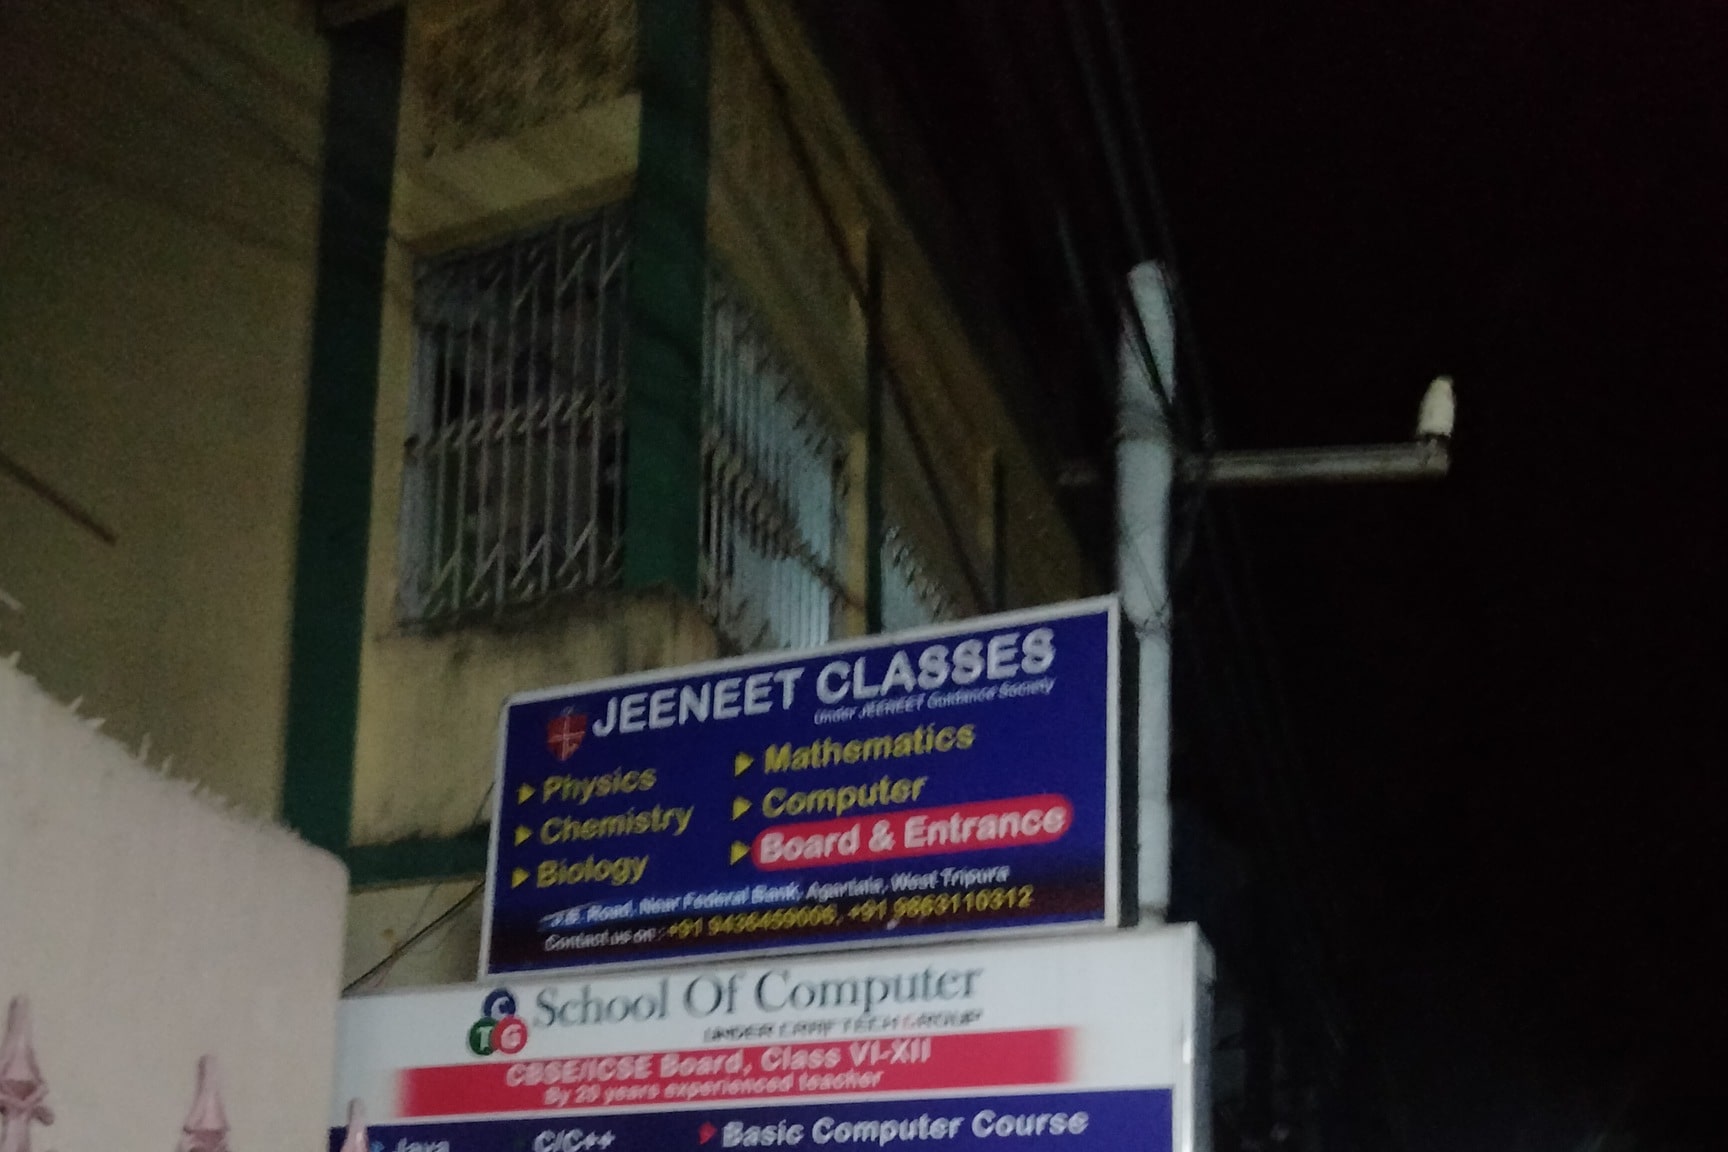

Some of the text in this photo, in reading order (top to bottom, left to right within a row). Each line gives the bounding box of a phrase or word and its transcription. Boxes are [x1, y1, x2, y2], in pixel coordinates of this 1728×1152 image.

[592, 627, 1056, 737] JEENEET CLASSES
[764, 723, 976, 774] Mathematics
[543, 767, 657, 805] Physics
[762, 776, 928, 818] Computer
[540, 804, 695, 845] Chemistry
[760, 806, 1067, 863] Board & Entrance
[536, 855, 649, 888] Biology
[683, 886, 750, 909] Federal
[940, 865, 1011, 889] Tripura
[533, 965, 984, 1027] School Of Computer
[506, 1037, 932, 1087] CBSE/ICSE Board, Class VI-XII
[545, 1086, 570, 1108] By
[603, 1082, 660, 1105] years
[664, 1073, 795, 1101] experienced
[799, 1069, 884, 1092] teacher
[722, 1109, 1090, 1148] Basic Computer Course
